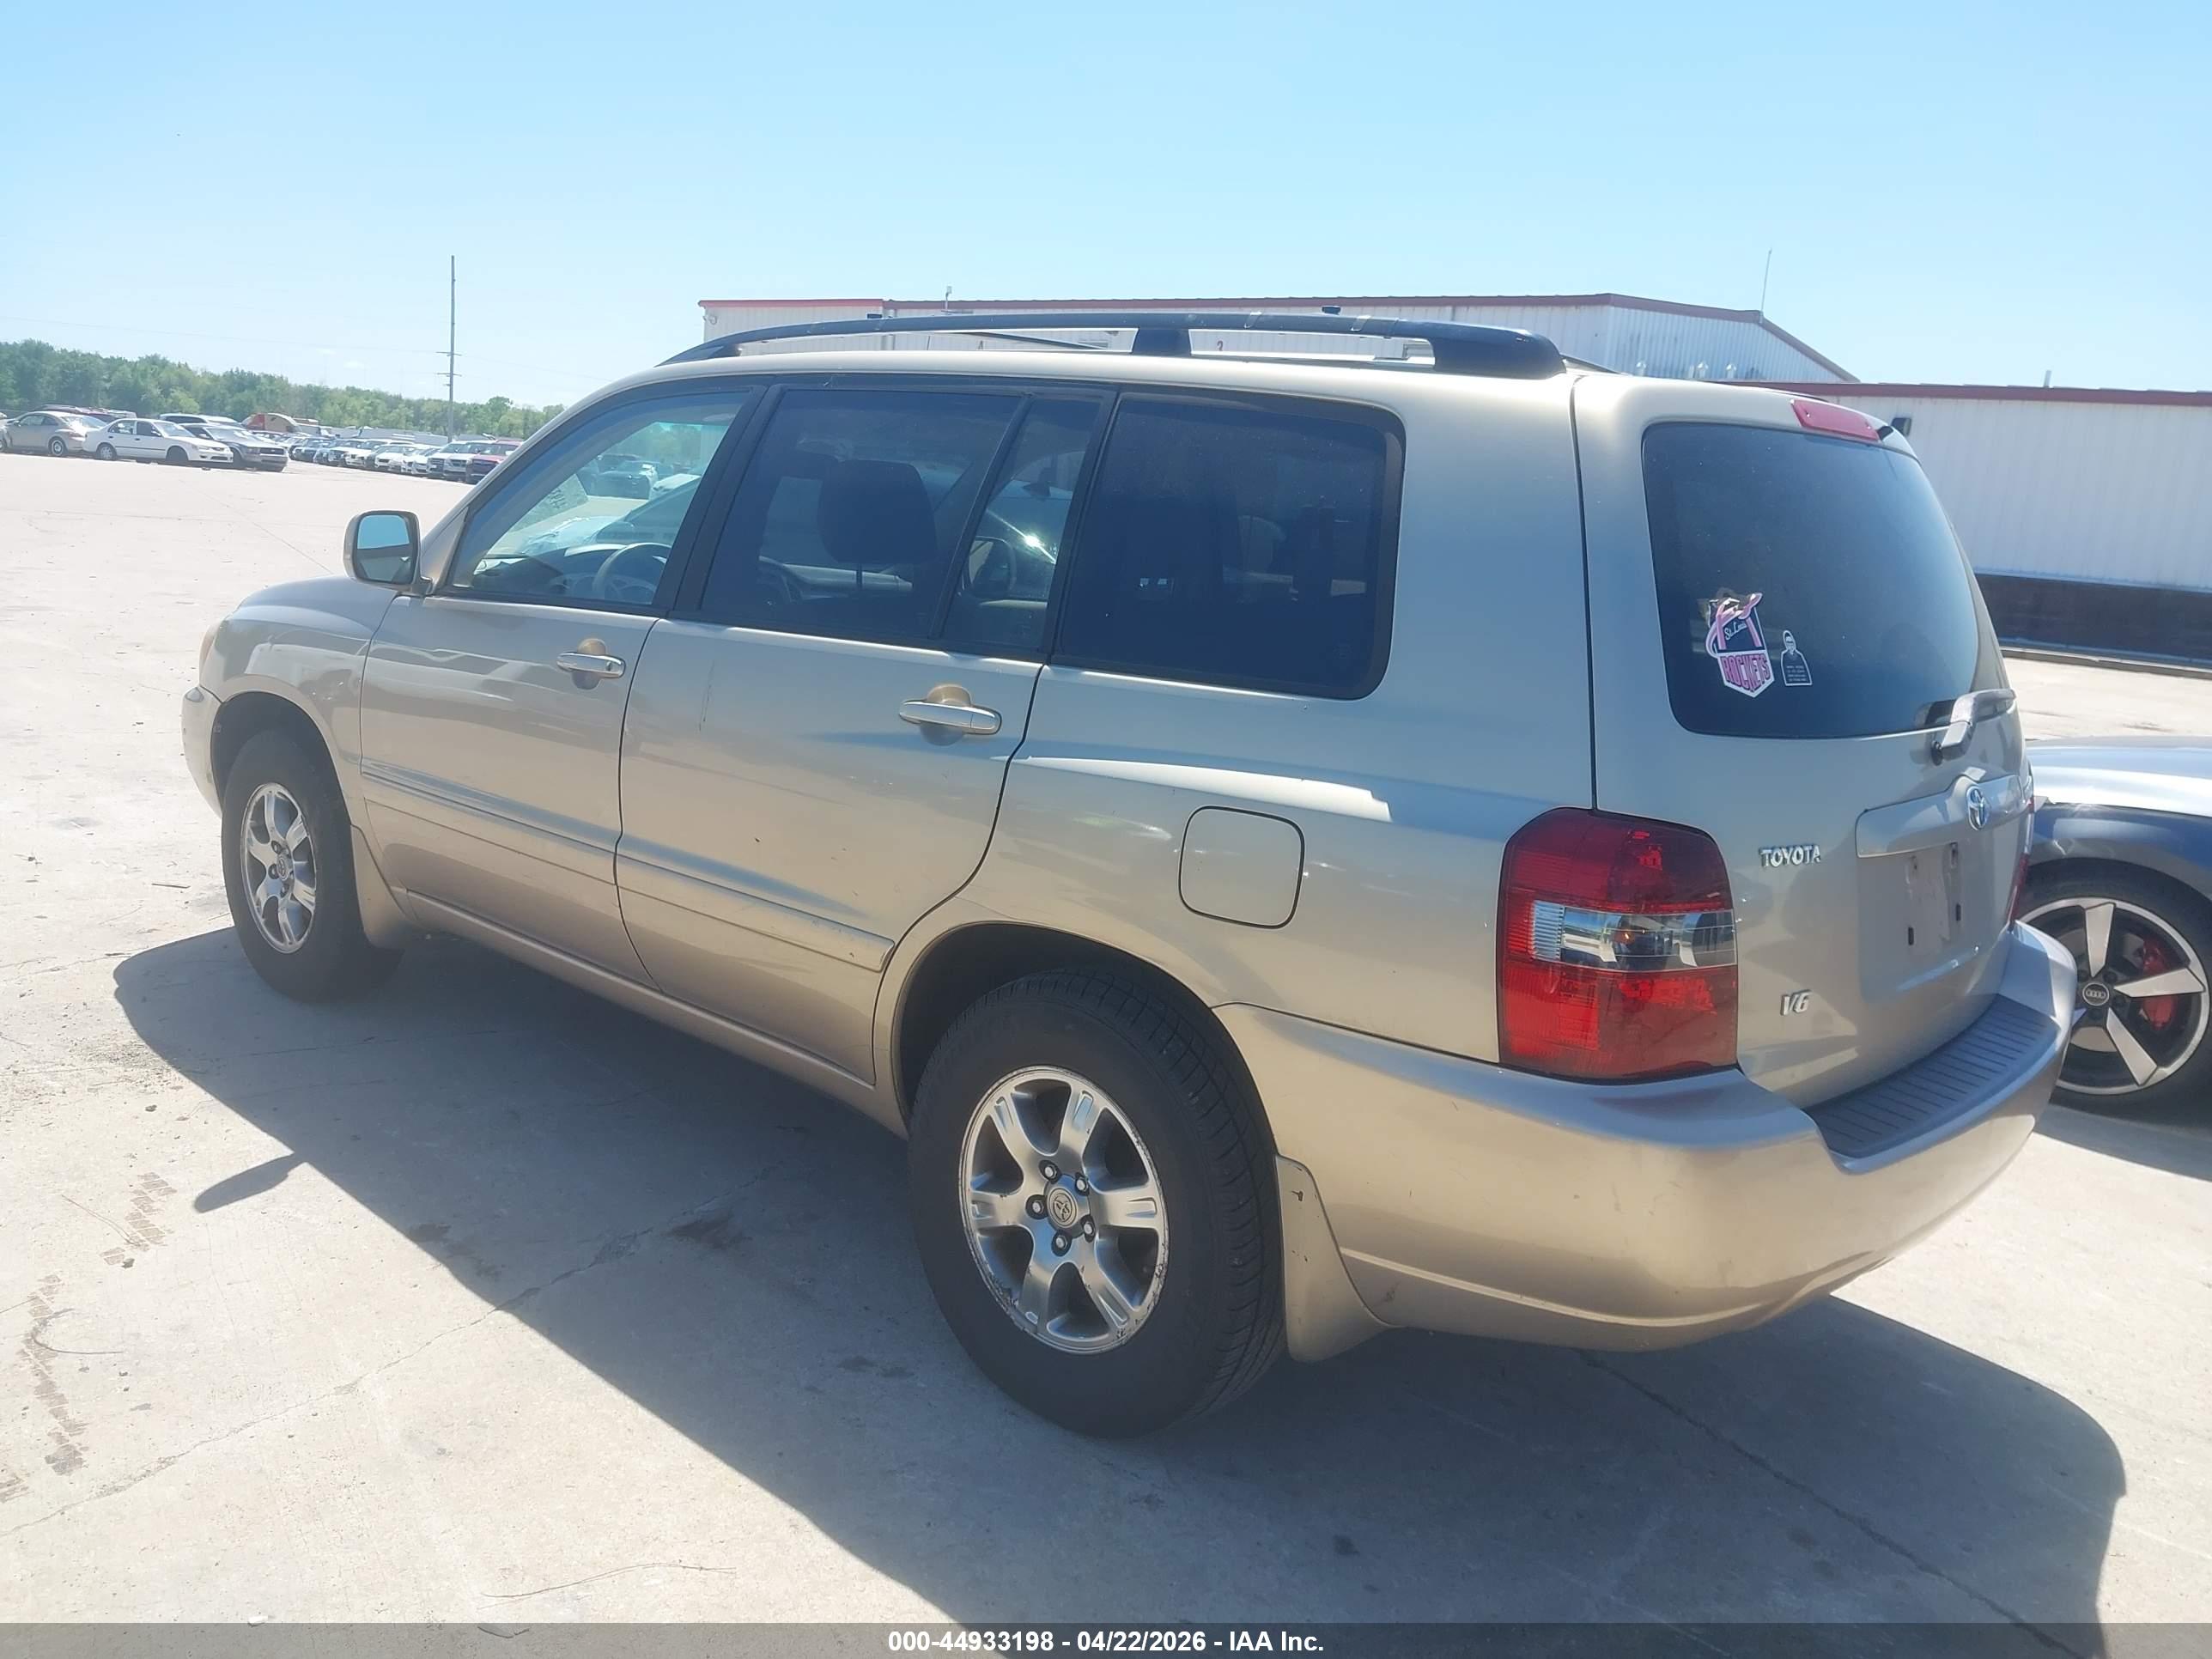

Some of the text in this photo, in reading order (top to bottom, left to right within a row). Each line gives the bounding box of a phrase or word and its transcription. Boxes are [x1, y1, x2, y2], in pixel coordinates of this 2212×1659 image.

[1721, 653, 1771, 692] ROCKETS
[1759, 845, 1820, 867] TOYOTA
[1780, 993, 1809, 1016] V6
